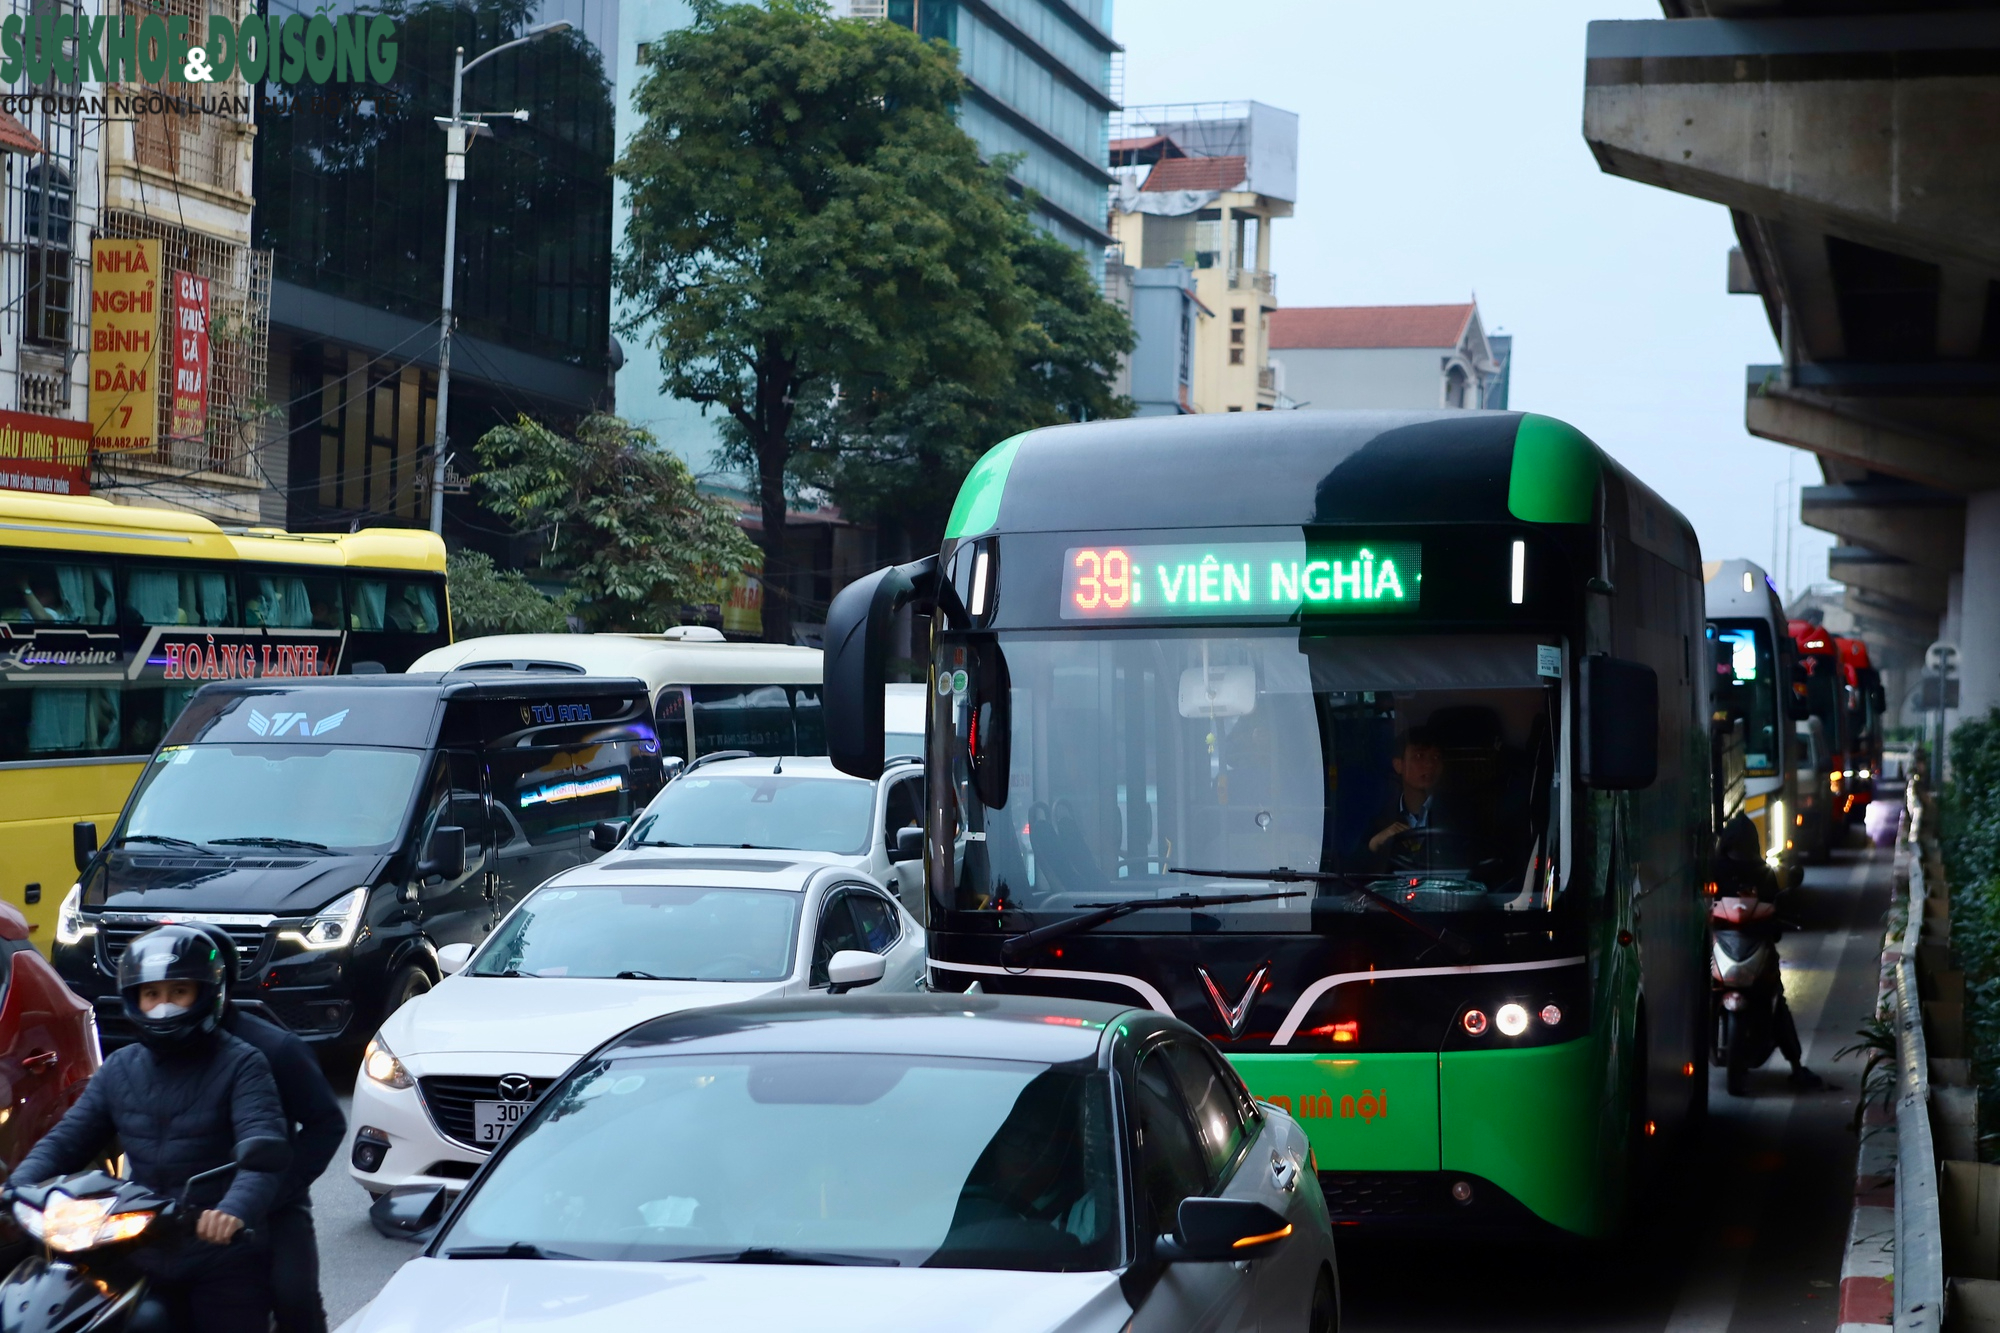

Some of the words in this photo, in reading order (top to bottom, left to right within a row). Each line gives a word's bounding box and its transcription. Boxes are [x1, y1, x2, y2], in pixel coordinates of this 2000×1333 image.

[97, 242, 149, 273] NHÀ
[92, 279, 155, 313] NGHỈ
[94, 322, 150, 353] BÌNH
[94, 362, 147, 392] DÂN
[56, 436, 89, 473] THỊNH
[1075, 550, 1129, 609] 39
[1158, 554, 1250, 603] VIÊN
[1270, 548, 1403, 601] NGHĨA
[0, 641, 117, 671] Limousine
[163, 633, 257, 680] HOÀNG
[260, 644, 319, 678] LINH
[557, 704, 592, 722] ANH
[1299, 1088, 1333, 1119] HÀ
[484, 1124, 514, 1140] 37
